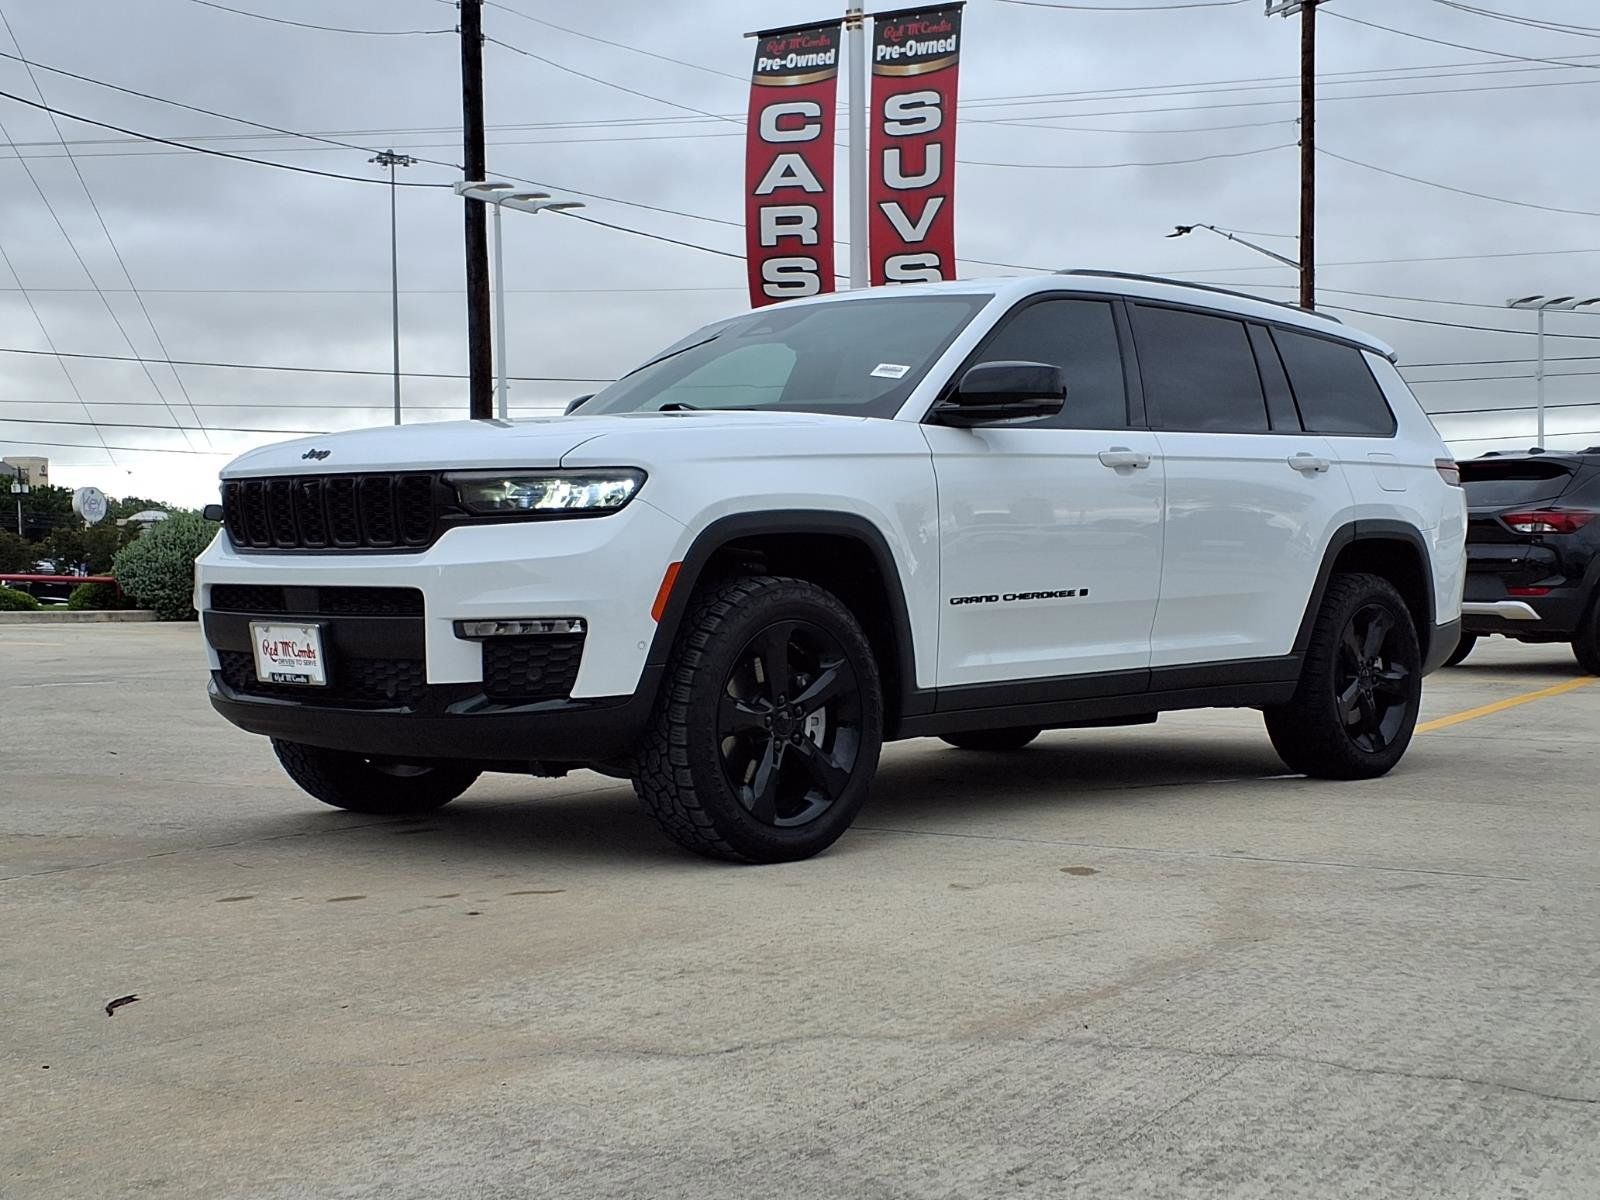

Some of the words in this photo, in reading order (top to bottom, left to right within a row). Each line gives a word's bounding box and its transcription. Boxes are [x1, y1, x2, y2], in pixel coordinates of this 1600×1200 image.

[876, 34, 958, 62] Pre-Owned
[757, 48, 836, 72] Pre-Owned
[880, 91, 944, 284] SUVS
[753, 102, 823, 298] CARS
[301, 447, 331, 461] Jeep
[949, 594, 999, 605] GRAND
[1002, 589, 1076, 602] CHEROKEE
[263, 639, 279, 662] Red
[303, 659, 317, 667] SERVE
